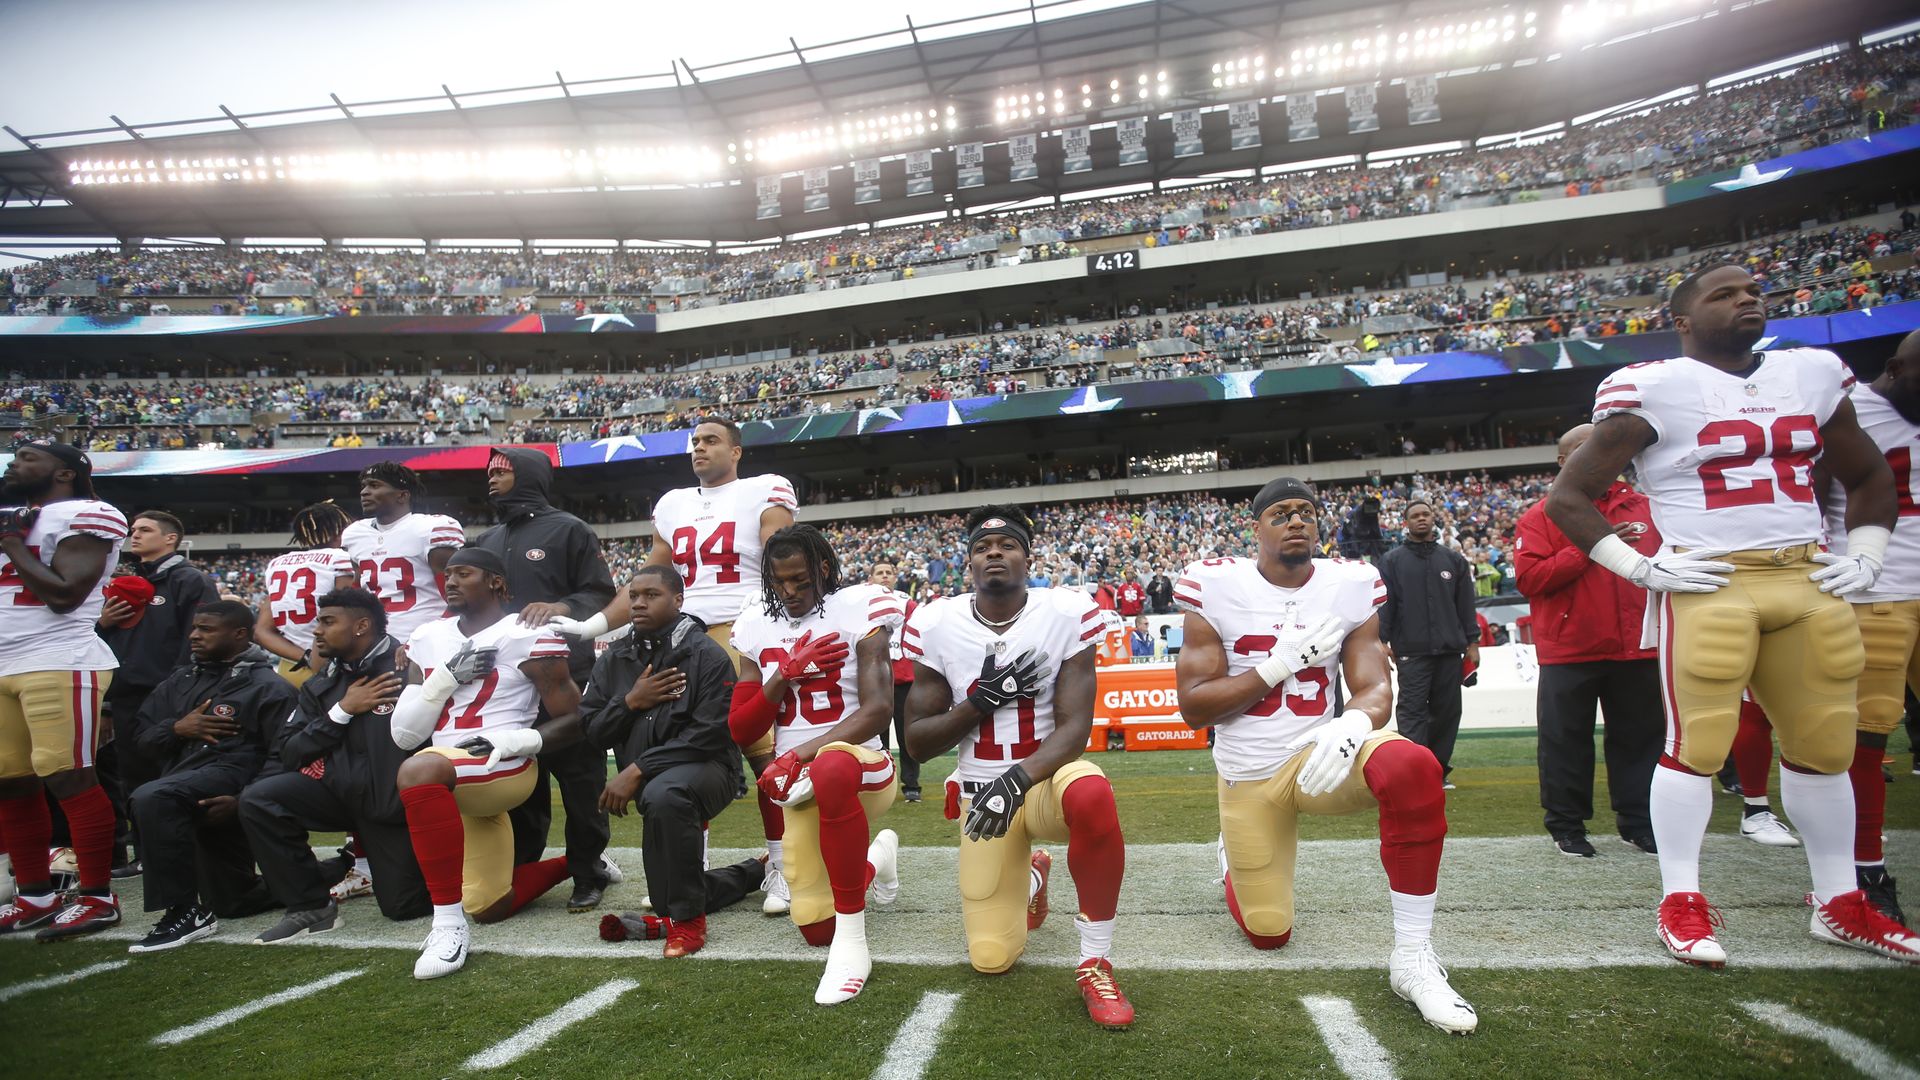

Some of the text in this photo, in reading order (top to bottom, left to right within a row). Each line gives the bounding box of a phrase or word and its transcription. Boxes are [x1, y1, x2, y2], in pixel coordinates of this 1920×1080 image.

[1349, 94, 1374, 106] 2010
[1231, 111, 1257, 122] 2004
[1175, 120, 1200, 131] 2003
[1119, 128, 1143, 140] 2002
[1065, 136, 1088, 148] 2001
[959, 153, 981, 163] 1980
[908, 161, 930, 172] 1960
[1095, 252, 1134, 270] 4:12
[1696, 414, 1824, 510] 28
[672, 521, 741, 588] 94
[270, 567, 318, 627] 23
[967, 678, 1042, 761] 11
[1136, 731, 1195, 741] GATORADE
